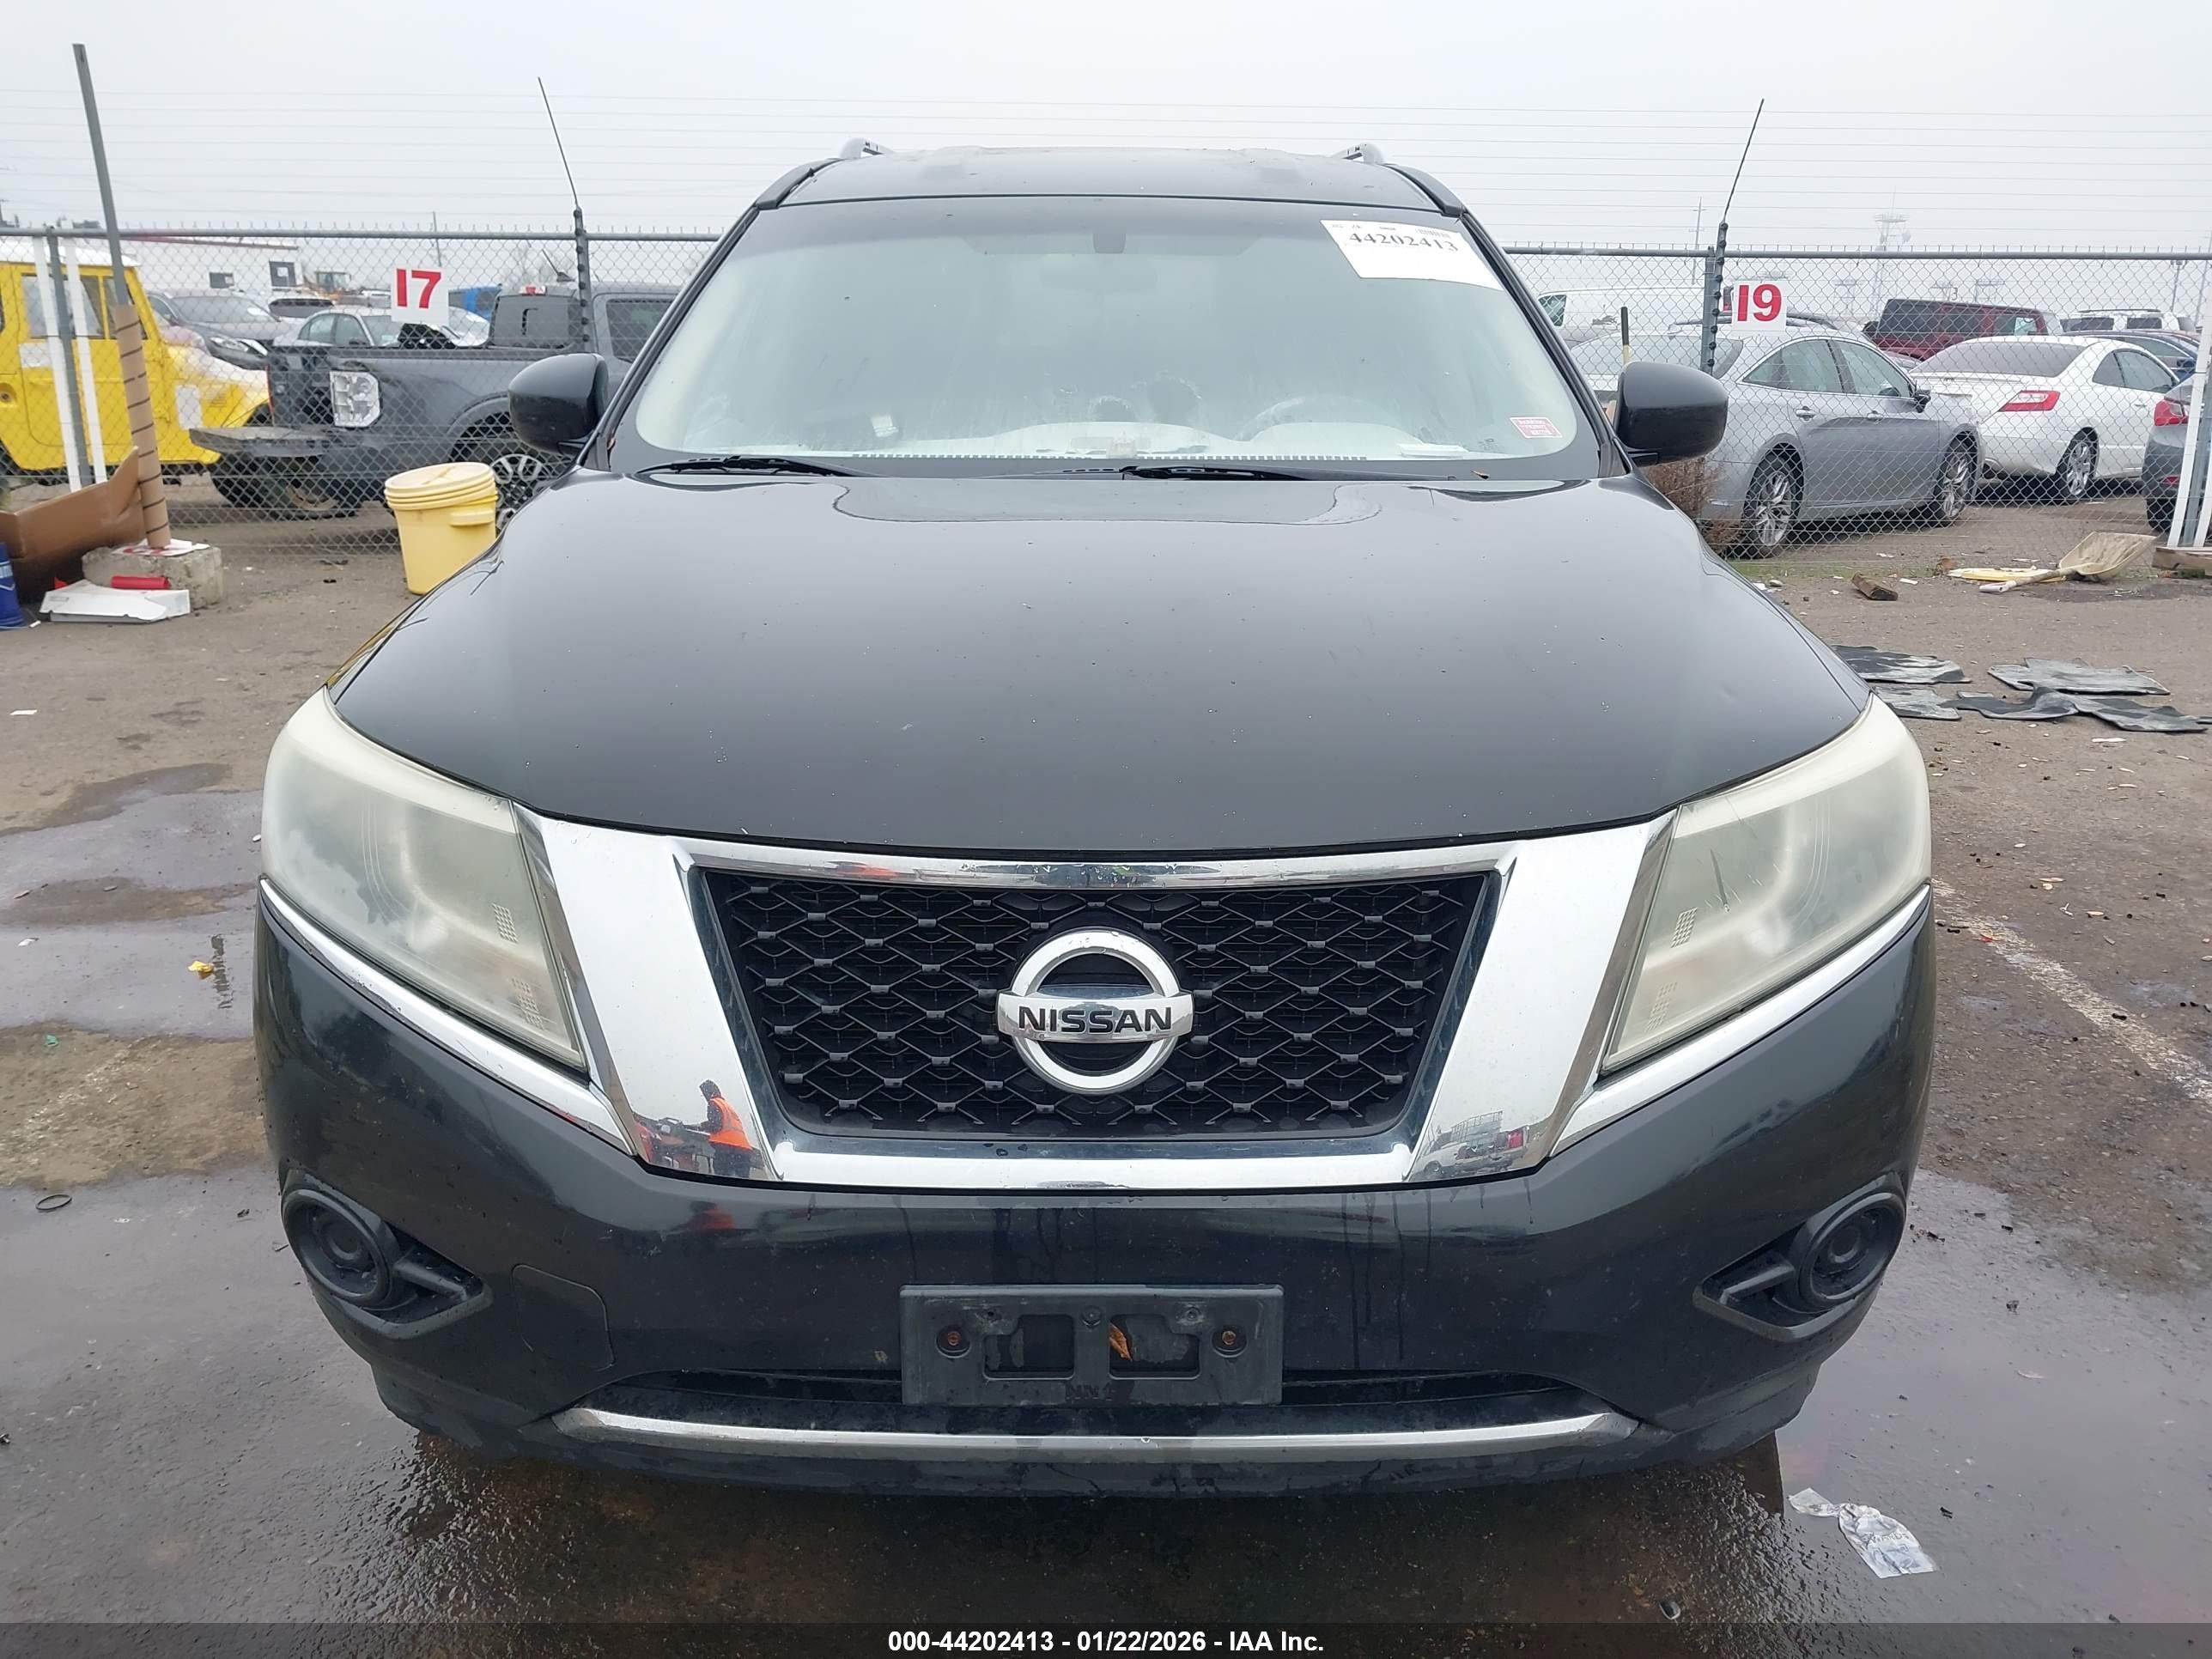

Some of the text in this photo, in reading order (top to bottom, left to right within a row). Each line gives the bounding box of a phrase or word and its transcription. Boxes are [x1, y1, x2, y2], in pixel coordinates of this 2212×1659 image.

[1349, 233, 1459, 252] 44202413
[397, 268, 441, 308] 17
[1737, 283, 1782, 322] 19
[1018, 1006, 1172, 1033] NISSAN
